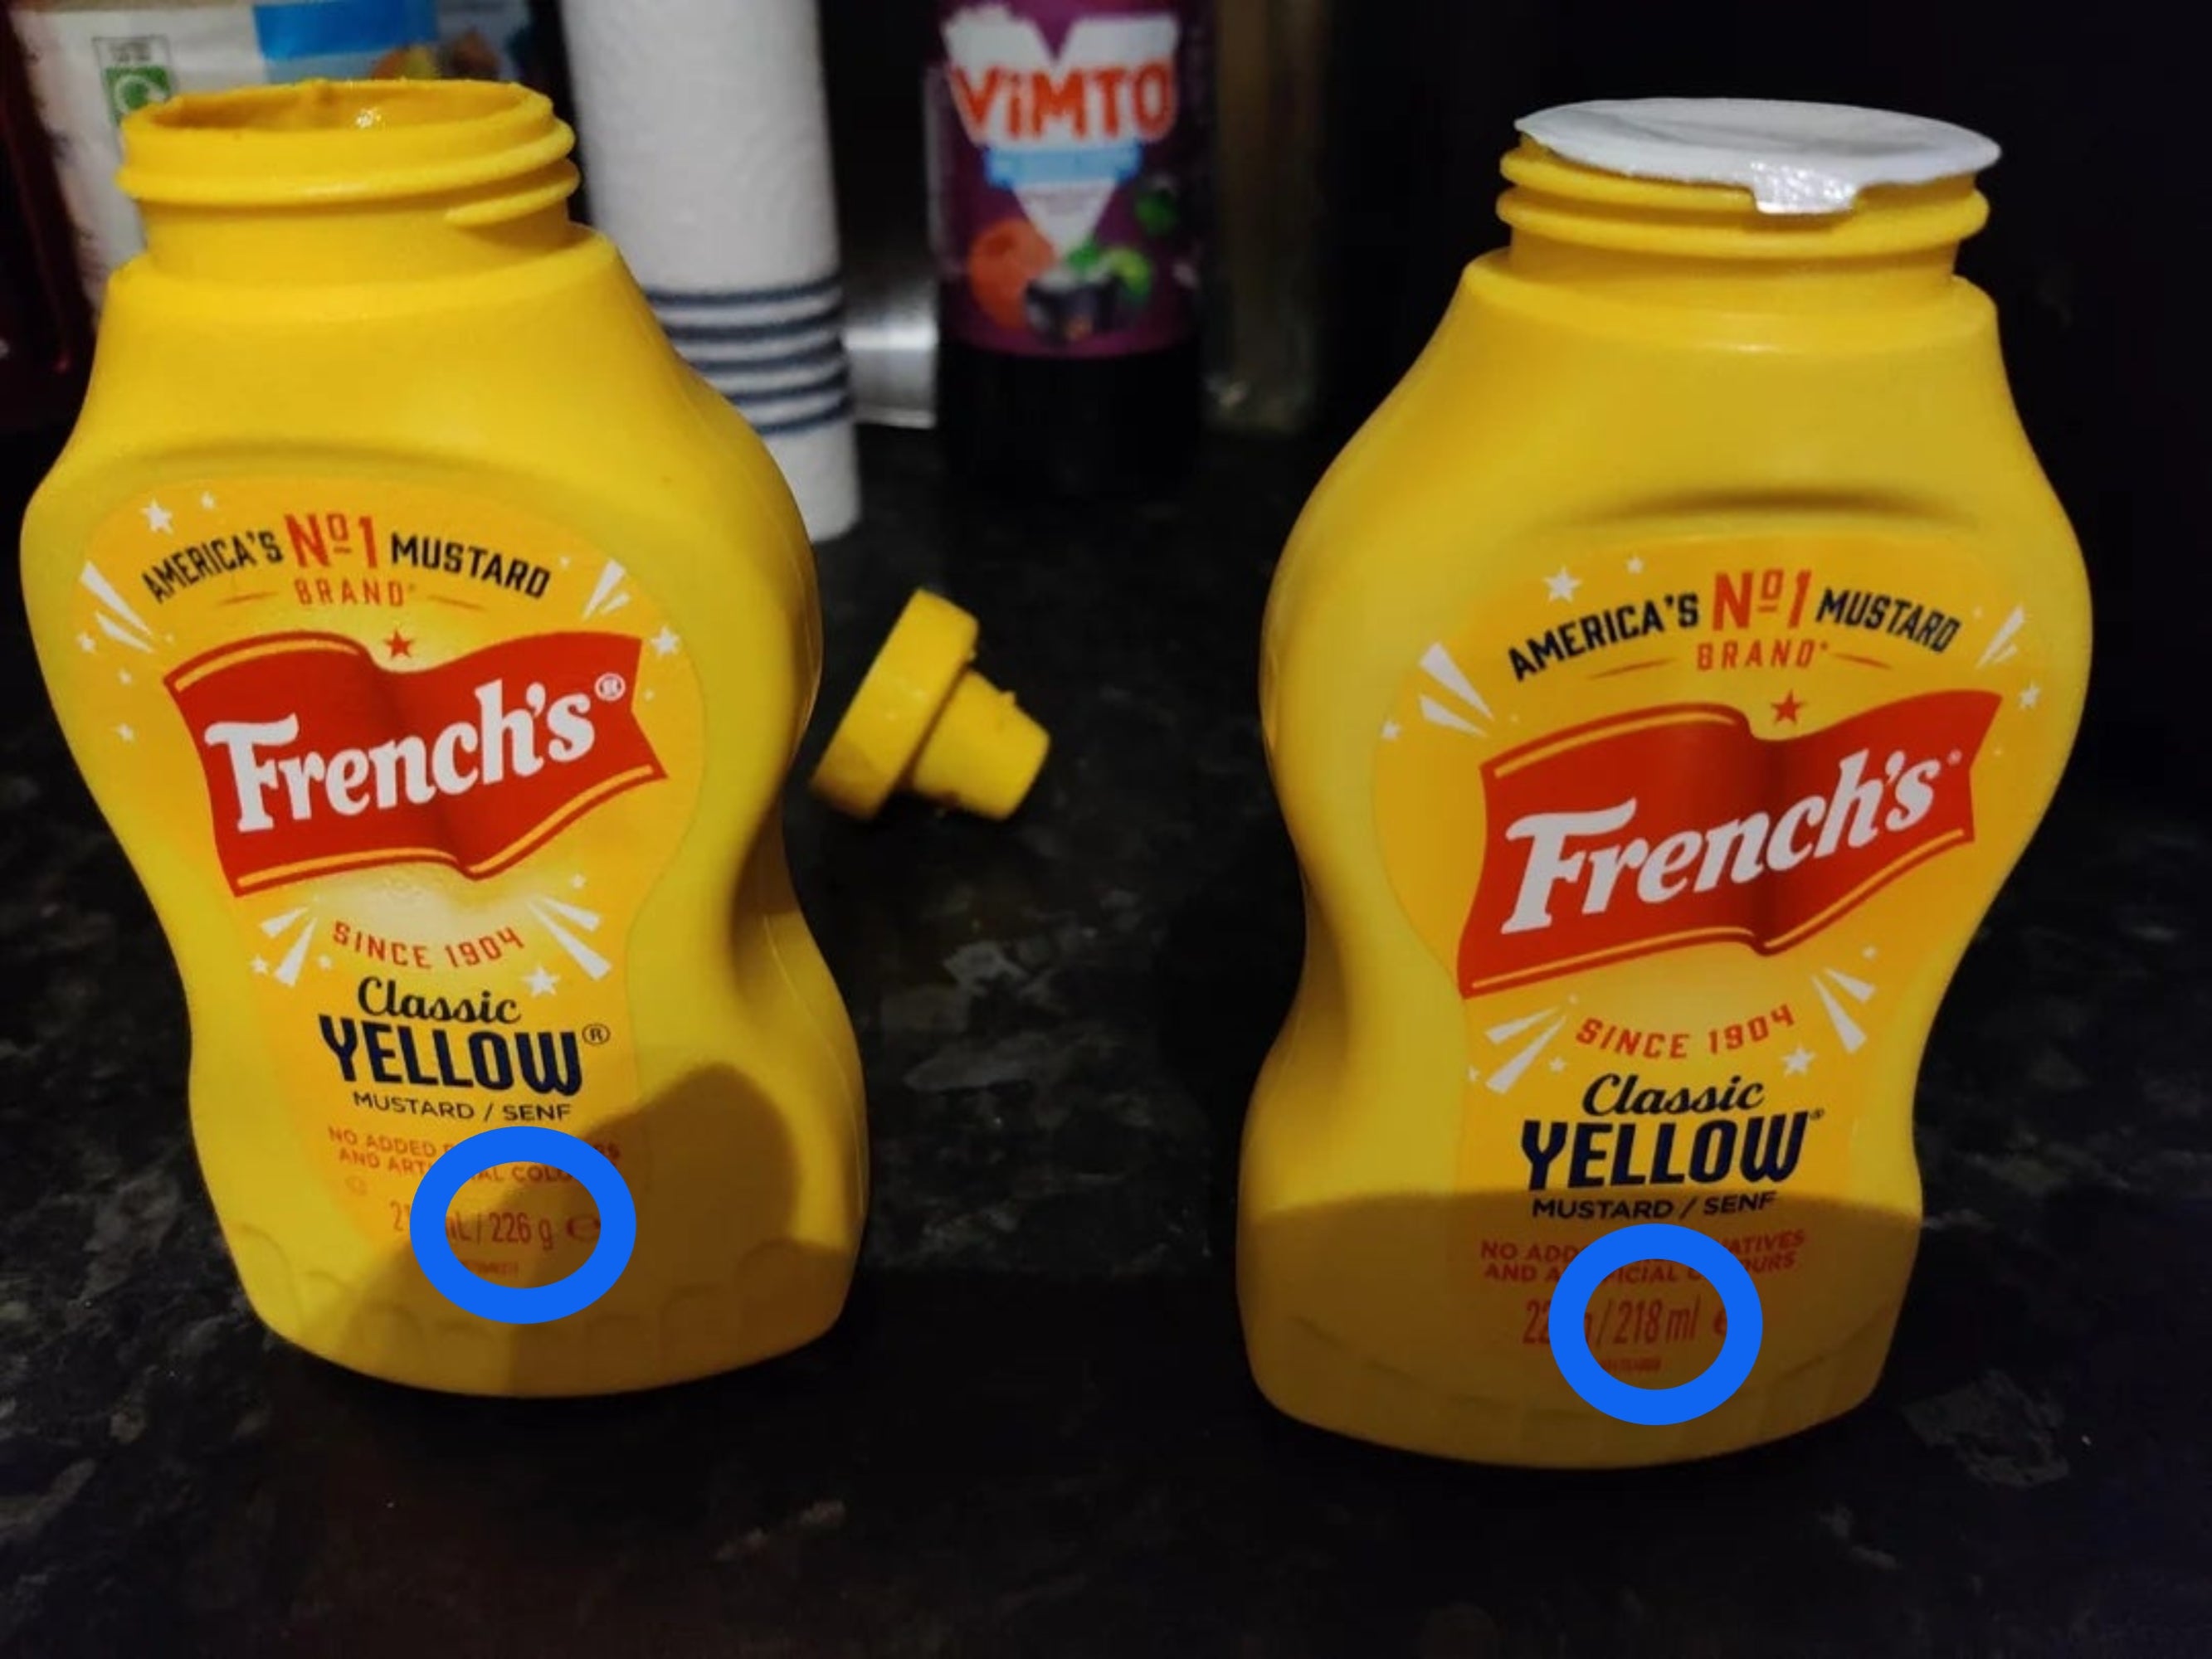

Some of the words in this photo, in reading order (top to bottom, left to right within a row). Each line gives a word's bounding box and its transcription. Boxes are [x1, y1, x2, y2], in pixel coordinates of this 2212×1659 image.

[141, 529, 284, 605] AMERICA'S
[391, 532, 551, 600] MUSTARD
[294, 578, 405, 607] BRAND
[1508, 592, 1698, 683] AMERICA'S
[1815, 586, 1961, 654] MUSTARD
[1697, 640, 1816, 670] BRAND
[204, 679, 595, 833] French's
[1501, 749, 1941, 935] French's
[333, 921, 432, 969] SINCE
[446, 927, 524, 968] 1904
[358, 976, 521, 1025] Classic
[1576, 1017, 1690, 1059] SINCE
[1709, 1004, 1795, 1054] 1904
[318, 1014, 582, 1096] YELLOW
[353, 1090, 475, 1120] MUSTARD
[503, 1103, 572, 1121] SENF
[1582, 1073, 1766, 1117] Classic
[329, 1126, 358, 1145] NO
[367, 1135, 436, 1158] ADDED
[339, 1148, 380, 1168] AND
[1521, 1111, 1810, 1191] YELLOW
[1532, 1197, 1674, 1220] MUSTARD
[1703, 1190, 1778, 1216] SENF
[489, 1212, 532, 1244] 226
[540, 1217, 553, 1251] g
[1481, 1240, 1518, 1260] NO
[1484, 1263, 1537, 1282] AND
[1613, 1299, 1663, 1345] 218
[1665, 1294, 1701, 1344] ml
